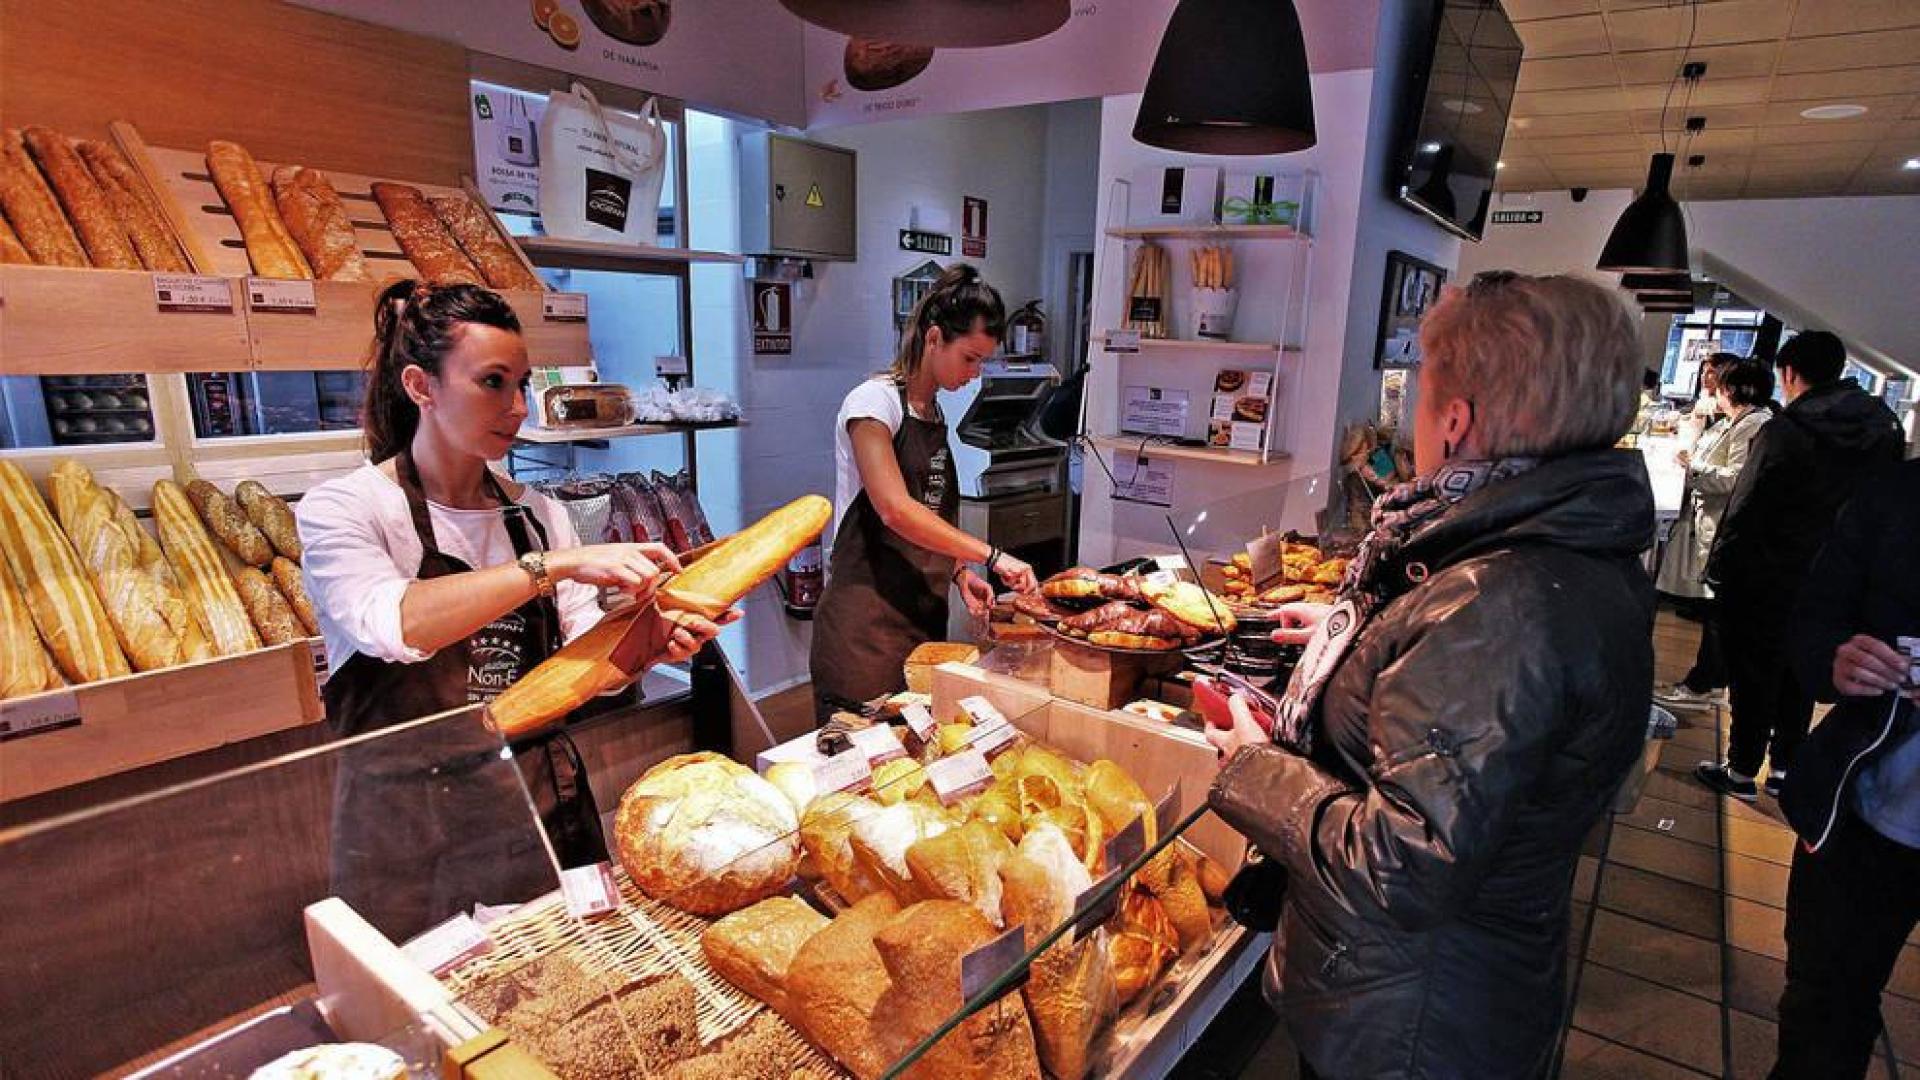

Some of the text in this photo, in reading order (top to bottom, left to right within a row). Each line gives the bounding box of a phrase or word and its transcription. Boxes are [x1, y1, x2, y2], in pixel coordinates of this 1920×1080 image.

[603, 49, 615, 60] DE
[916, 233, 949, 253] SALIDA
[467, 664, 519, 686] Non-E
